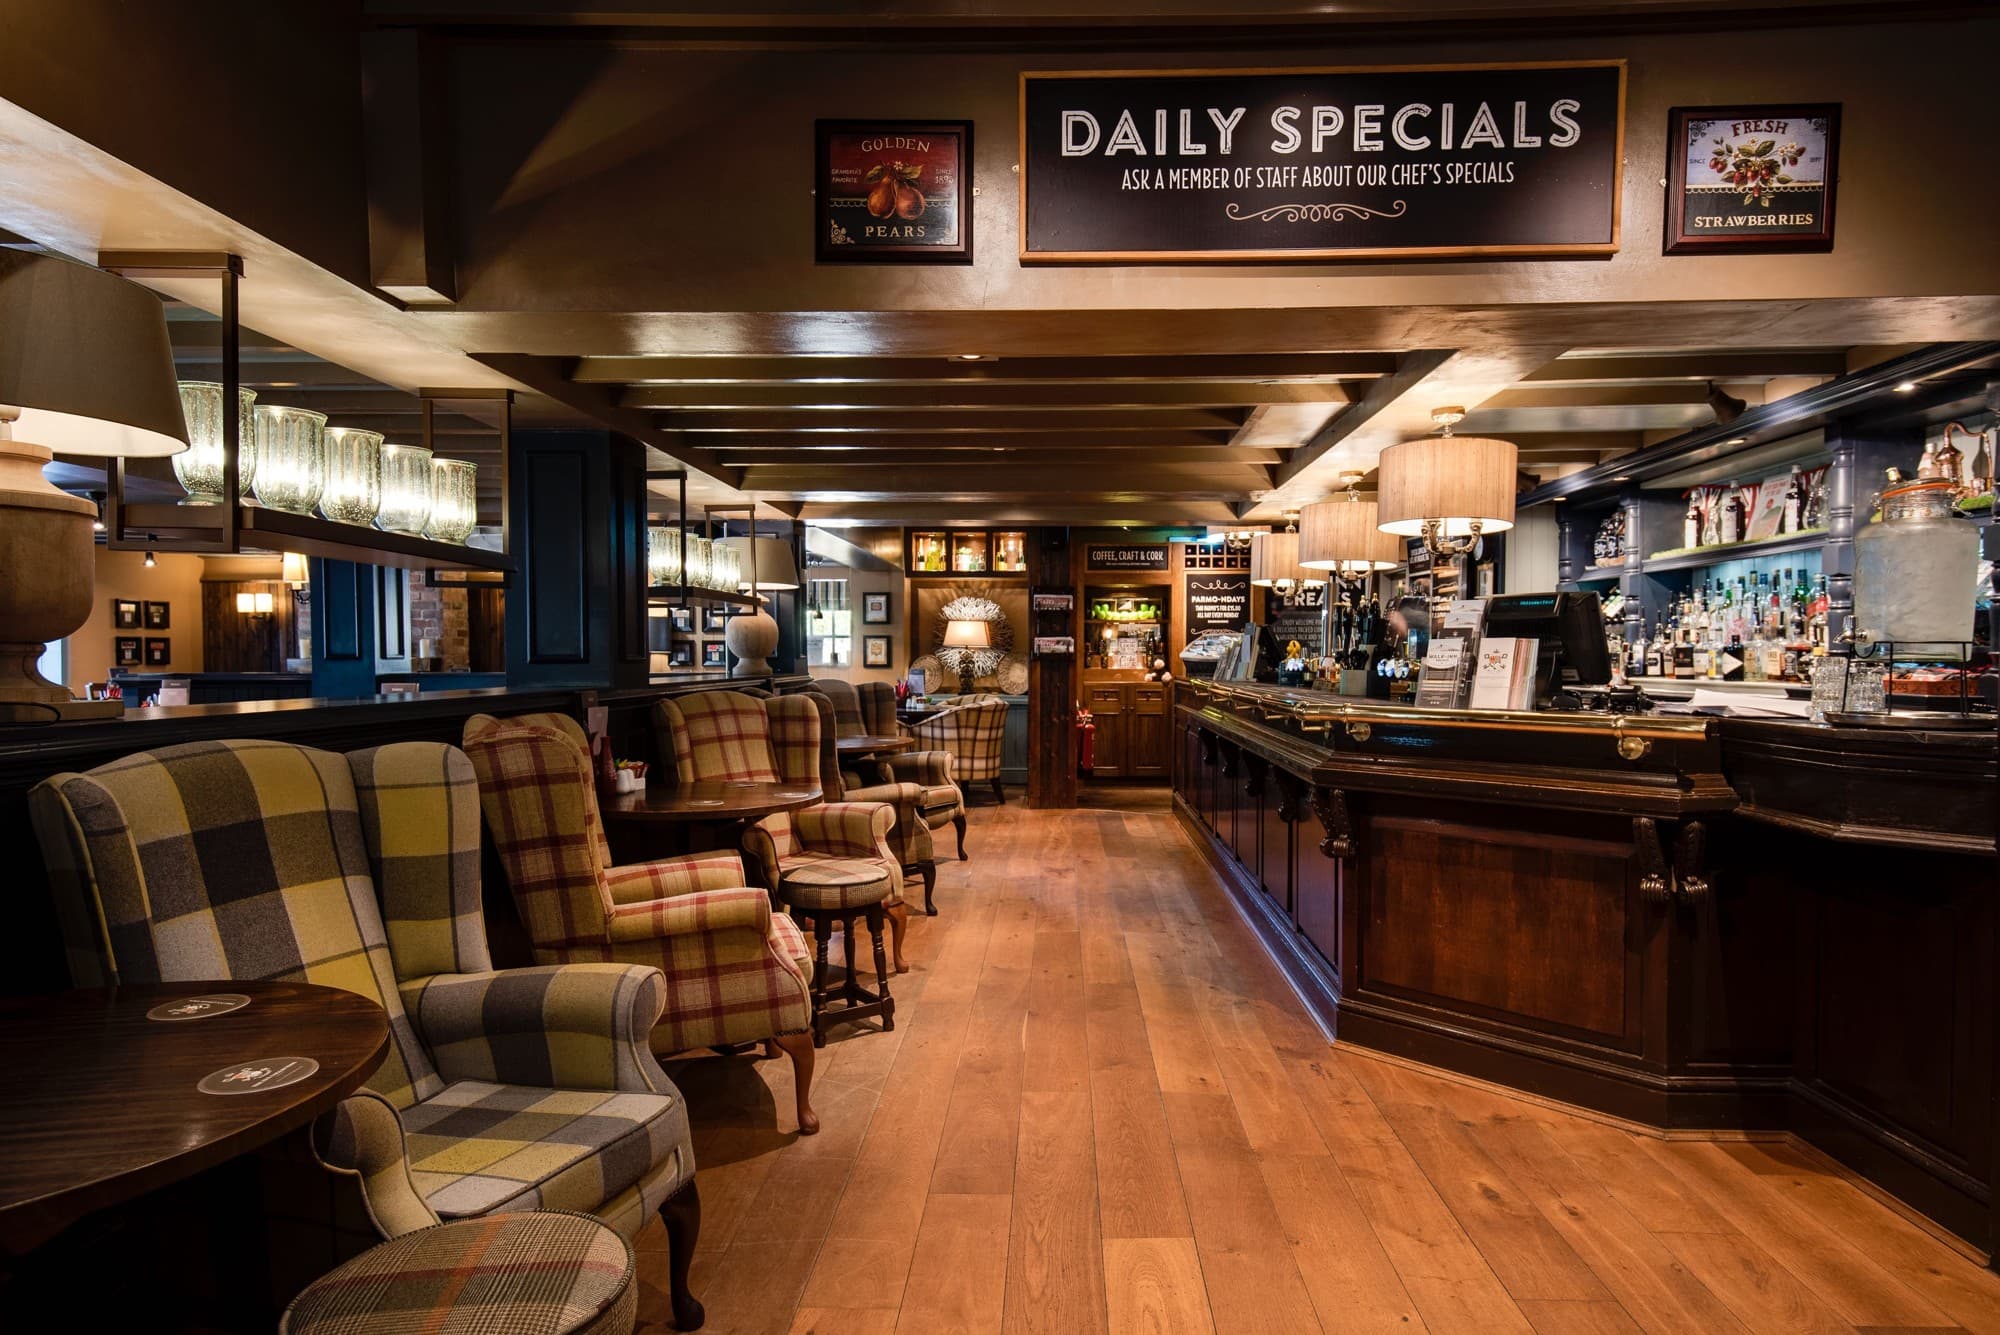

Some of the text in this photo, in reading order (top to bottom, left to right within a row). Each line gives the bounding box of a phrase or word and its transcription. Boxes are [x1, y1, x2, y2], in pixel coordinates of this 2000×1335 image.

[1061, 98, 1581, 156] DAILY SPECIALS
[1731, 119, 1789, 137] FRESH
[861, 137, 931, 153] GOLDEN
[1121, 161, 1515, 190] ASK A MEMBER OF STAFF ABOUT OUR CHEF'S SPECIALS
[1694, 213, 1814, 228] STRAWBERRIES
[865, 225, 926, 238] PEARS
[1119, 551, 1138, 560] CRAFT
[1140, 551, 1145, 560] &
[1146, 551, 1164, 560] CORK
